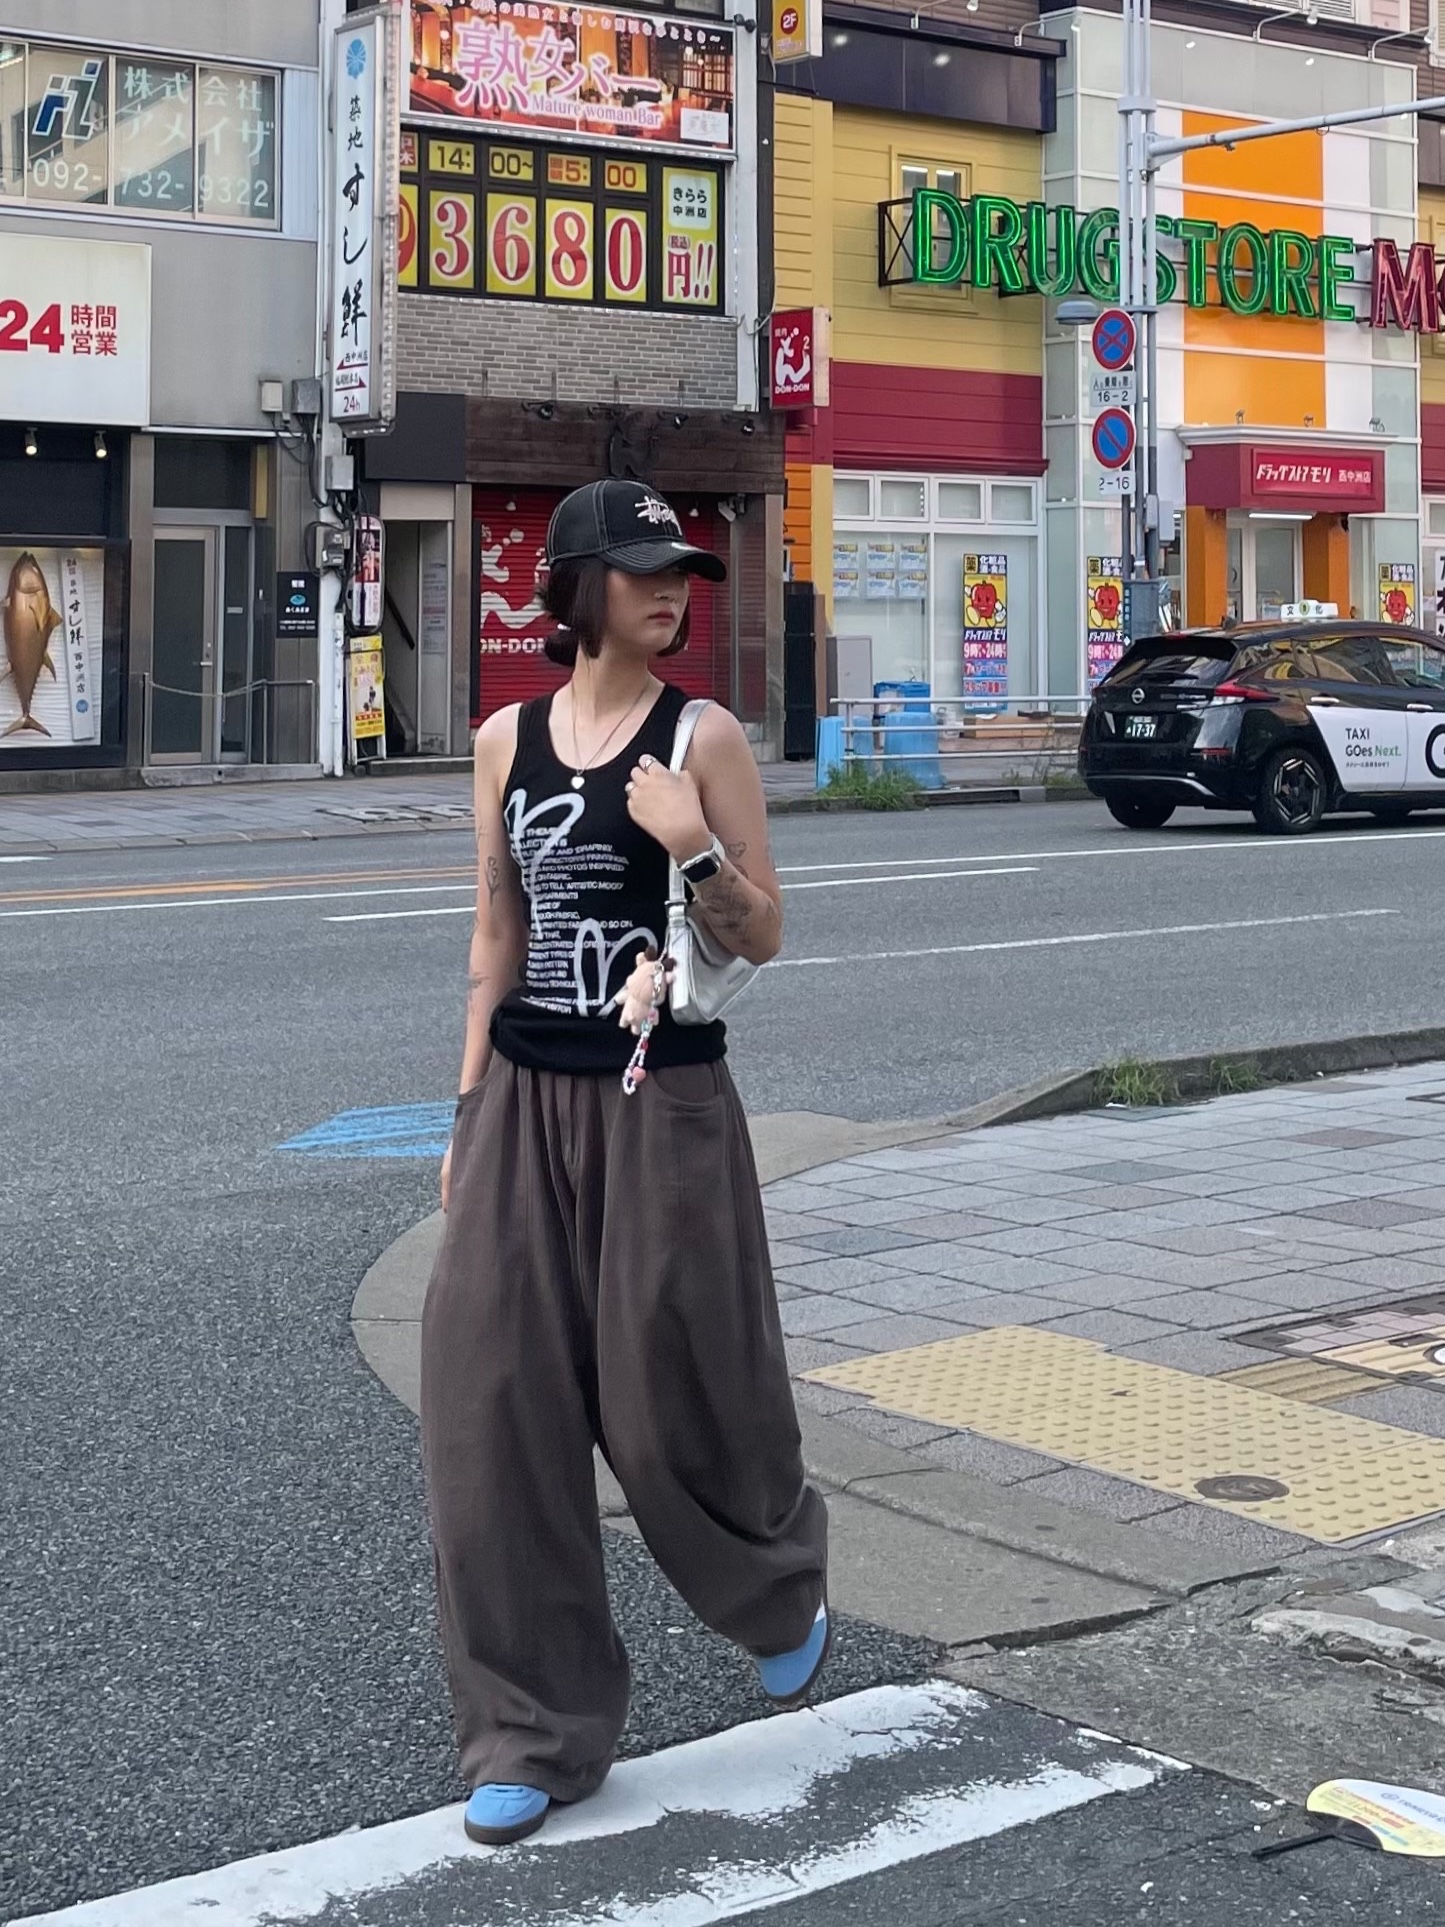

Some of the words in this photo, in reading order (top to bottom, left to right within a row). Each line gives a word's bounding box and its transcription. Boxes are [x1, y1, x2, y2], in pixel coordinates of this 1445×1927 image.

[783, 12, 797, 29] 2F
[456, 22, 660, 107] 熟女バー
[124, 66, 263, 112] 株式会社
[532, 98, 581, 118] Mature
[585, 108, 635, 123] woman
[637, 107, 661, 127] Bar
[607, 164, 636, 188] 00
[673, 187, 708, 204] きらら
[673, 205, 707, 218] 中洲店
[912, 187, 1132, 302] DRUG
[1143, 215, 1355, 321] STORE
[1369, 237, 1445, 333] M
[0, 300, 65, 354] 24
[71, 304, 117, 330] 時間
[71, 330, 118, 357] 営業
[803, 335, 810, 350] 2
[775, 383, 810, 394] DON-DON
[343, 395, 361, 413] 24h
[1256, 463, 1332, 483] ドラッグストアモリ
[480, 637, 545, 653] ON-DO
[1345, 727, 1370, 740] TAXI
[1345, 744, 1373, 757] GOes
